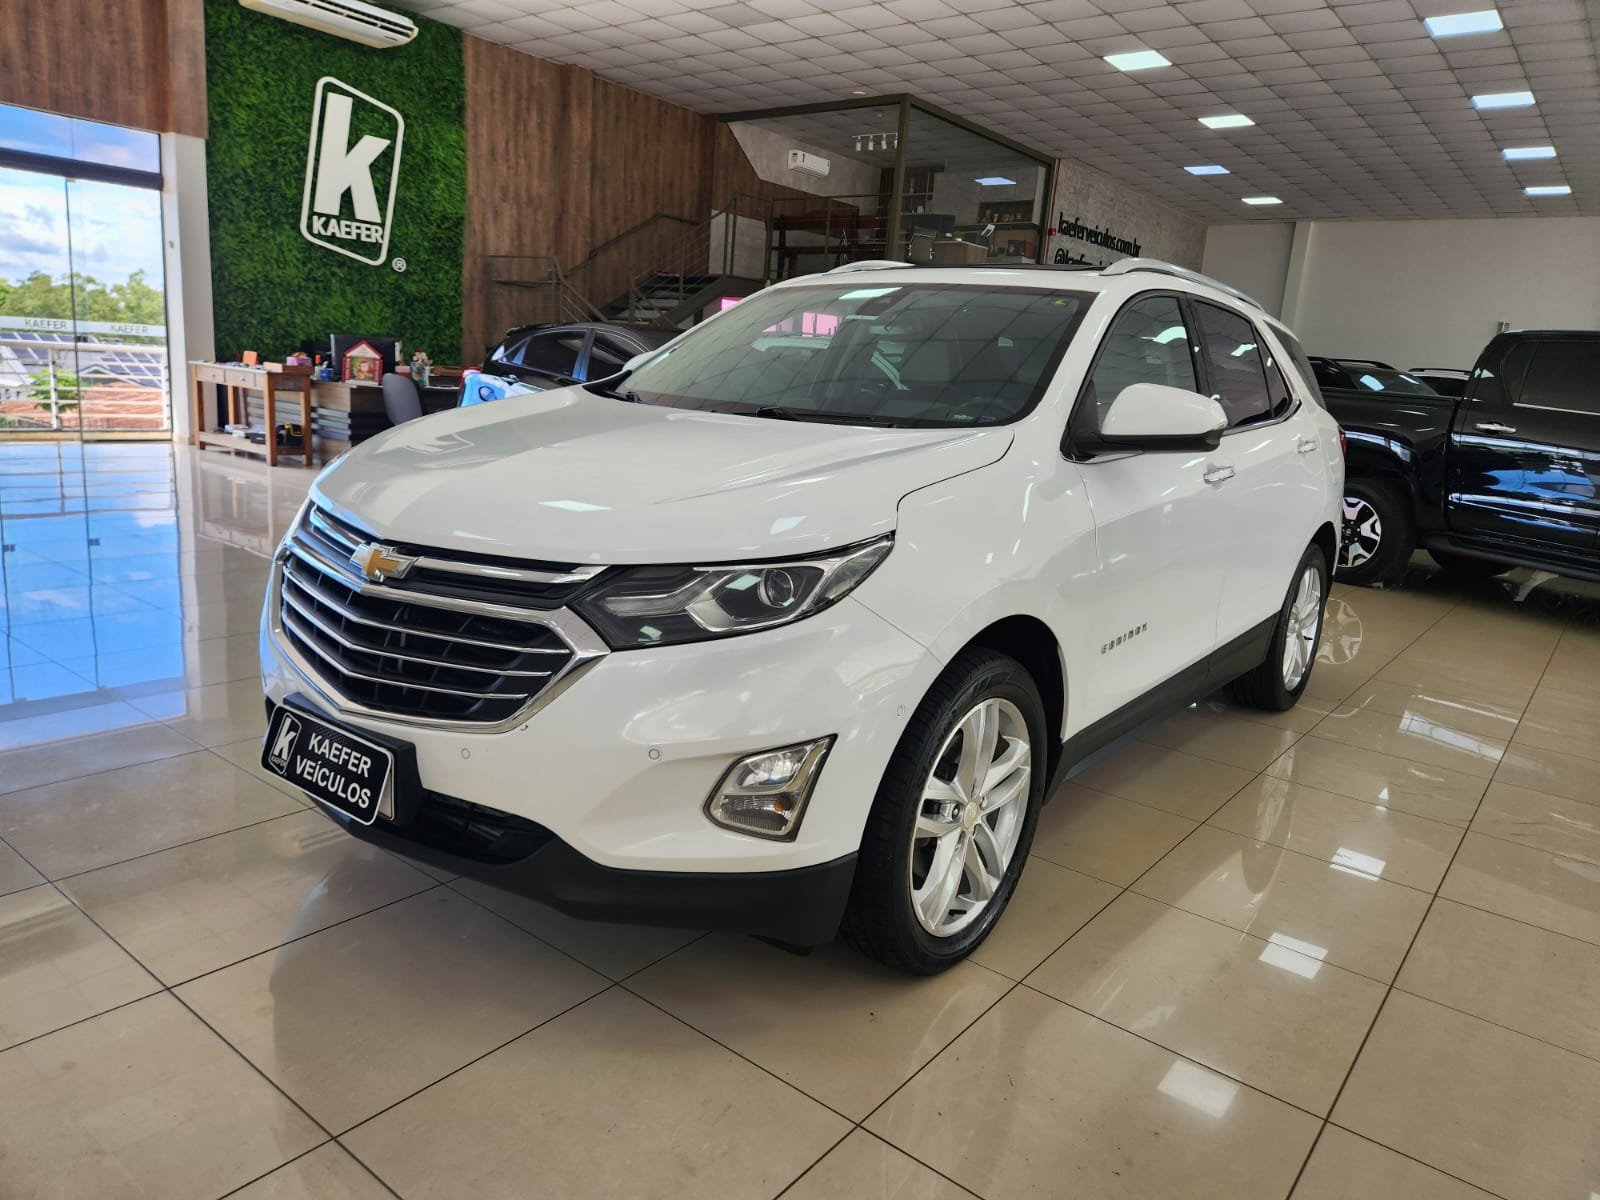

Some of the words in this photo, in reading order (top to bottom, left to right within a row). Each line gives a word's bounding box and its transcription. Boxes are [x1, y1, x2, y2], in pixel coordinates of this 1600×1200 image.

[312, 215, 384, 244] KAEFER
[24, 318, 67, 330] KAEFER
[110, 324, 149, 334] KAEFER
[308, 732, 372, 778] KAEFER
[296, 754, 371, 809] VEÍCULOS
